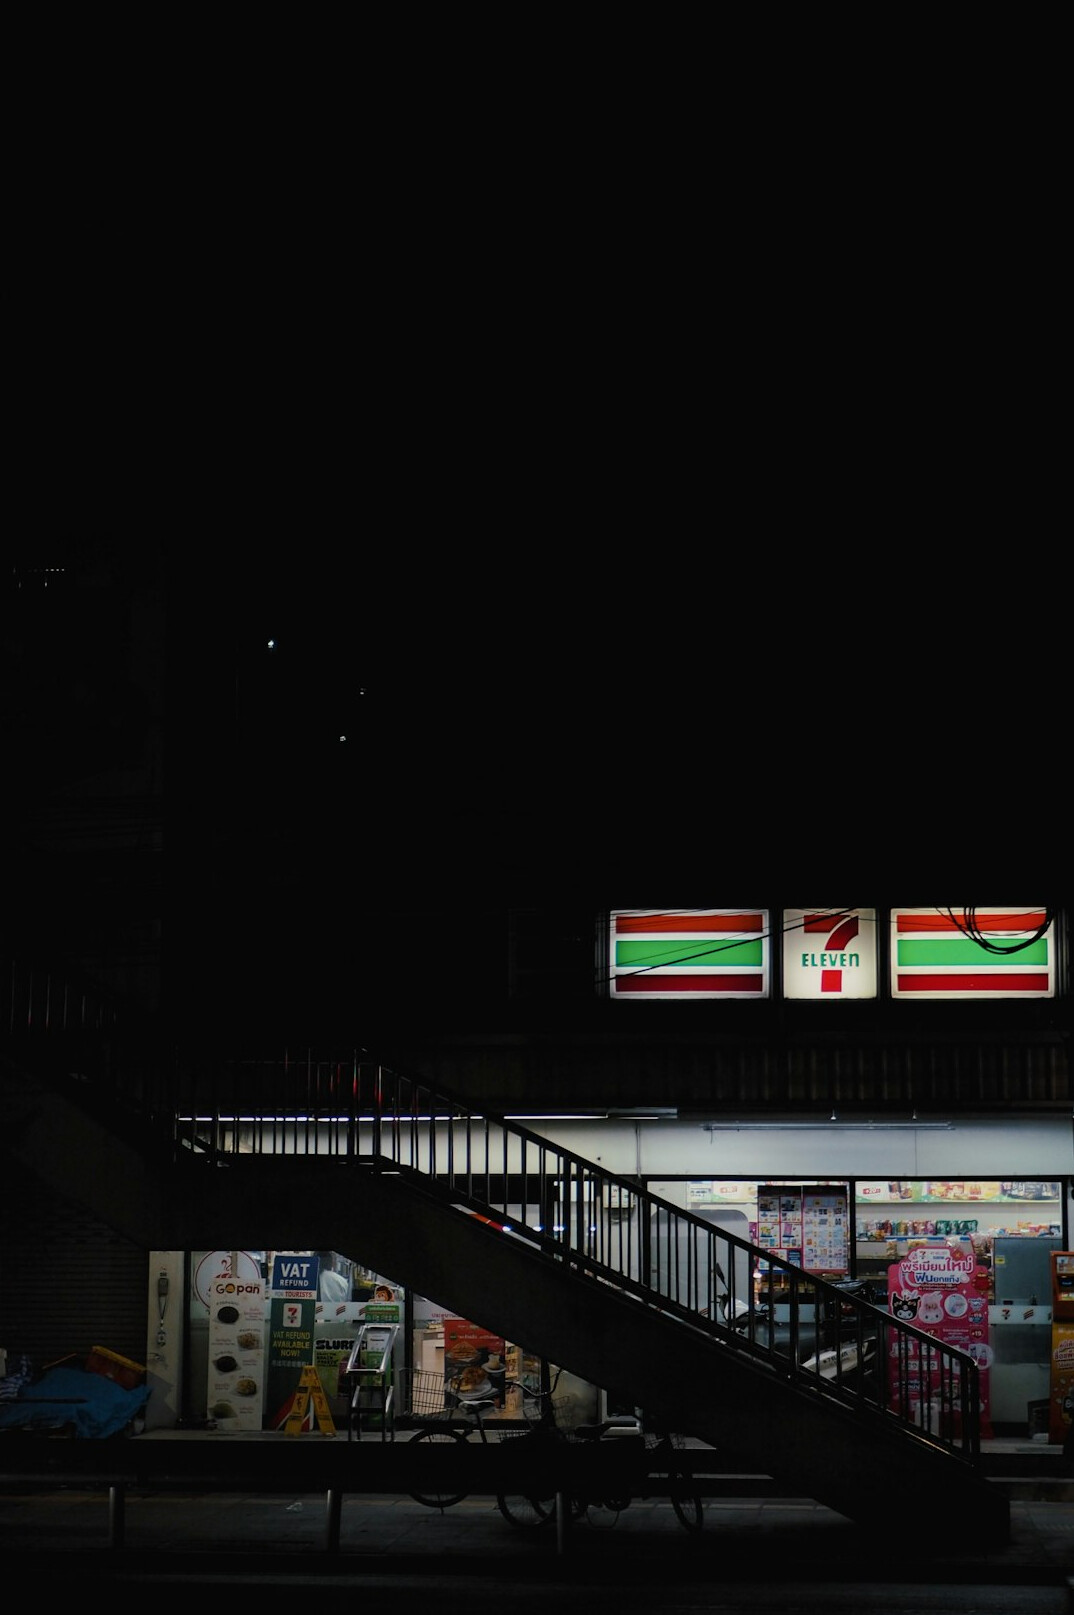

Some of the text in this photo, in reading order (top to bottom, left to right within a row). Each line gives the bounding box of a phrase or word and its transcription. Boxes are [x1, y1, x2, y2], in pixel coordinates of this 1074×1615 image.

[281, 1263, 310, 1278] VAT
[272, 1331, 311, 1340] VAT REFUND
[272, 1340, 311, 1349] AVAILABLE
